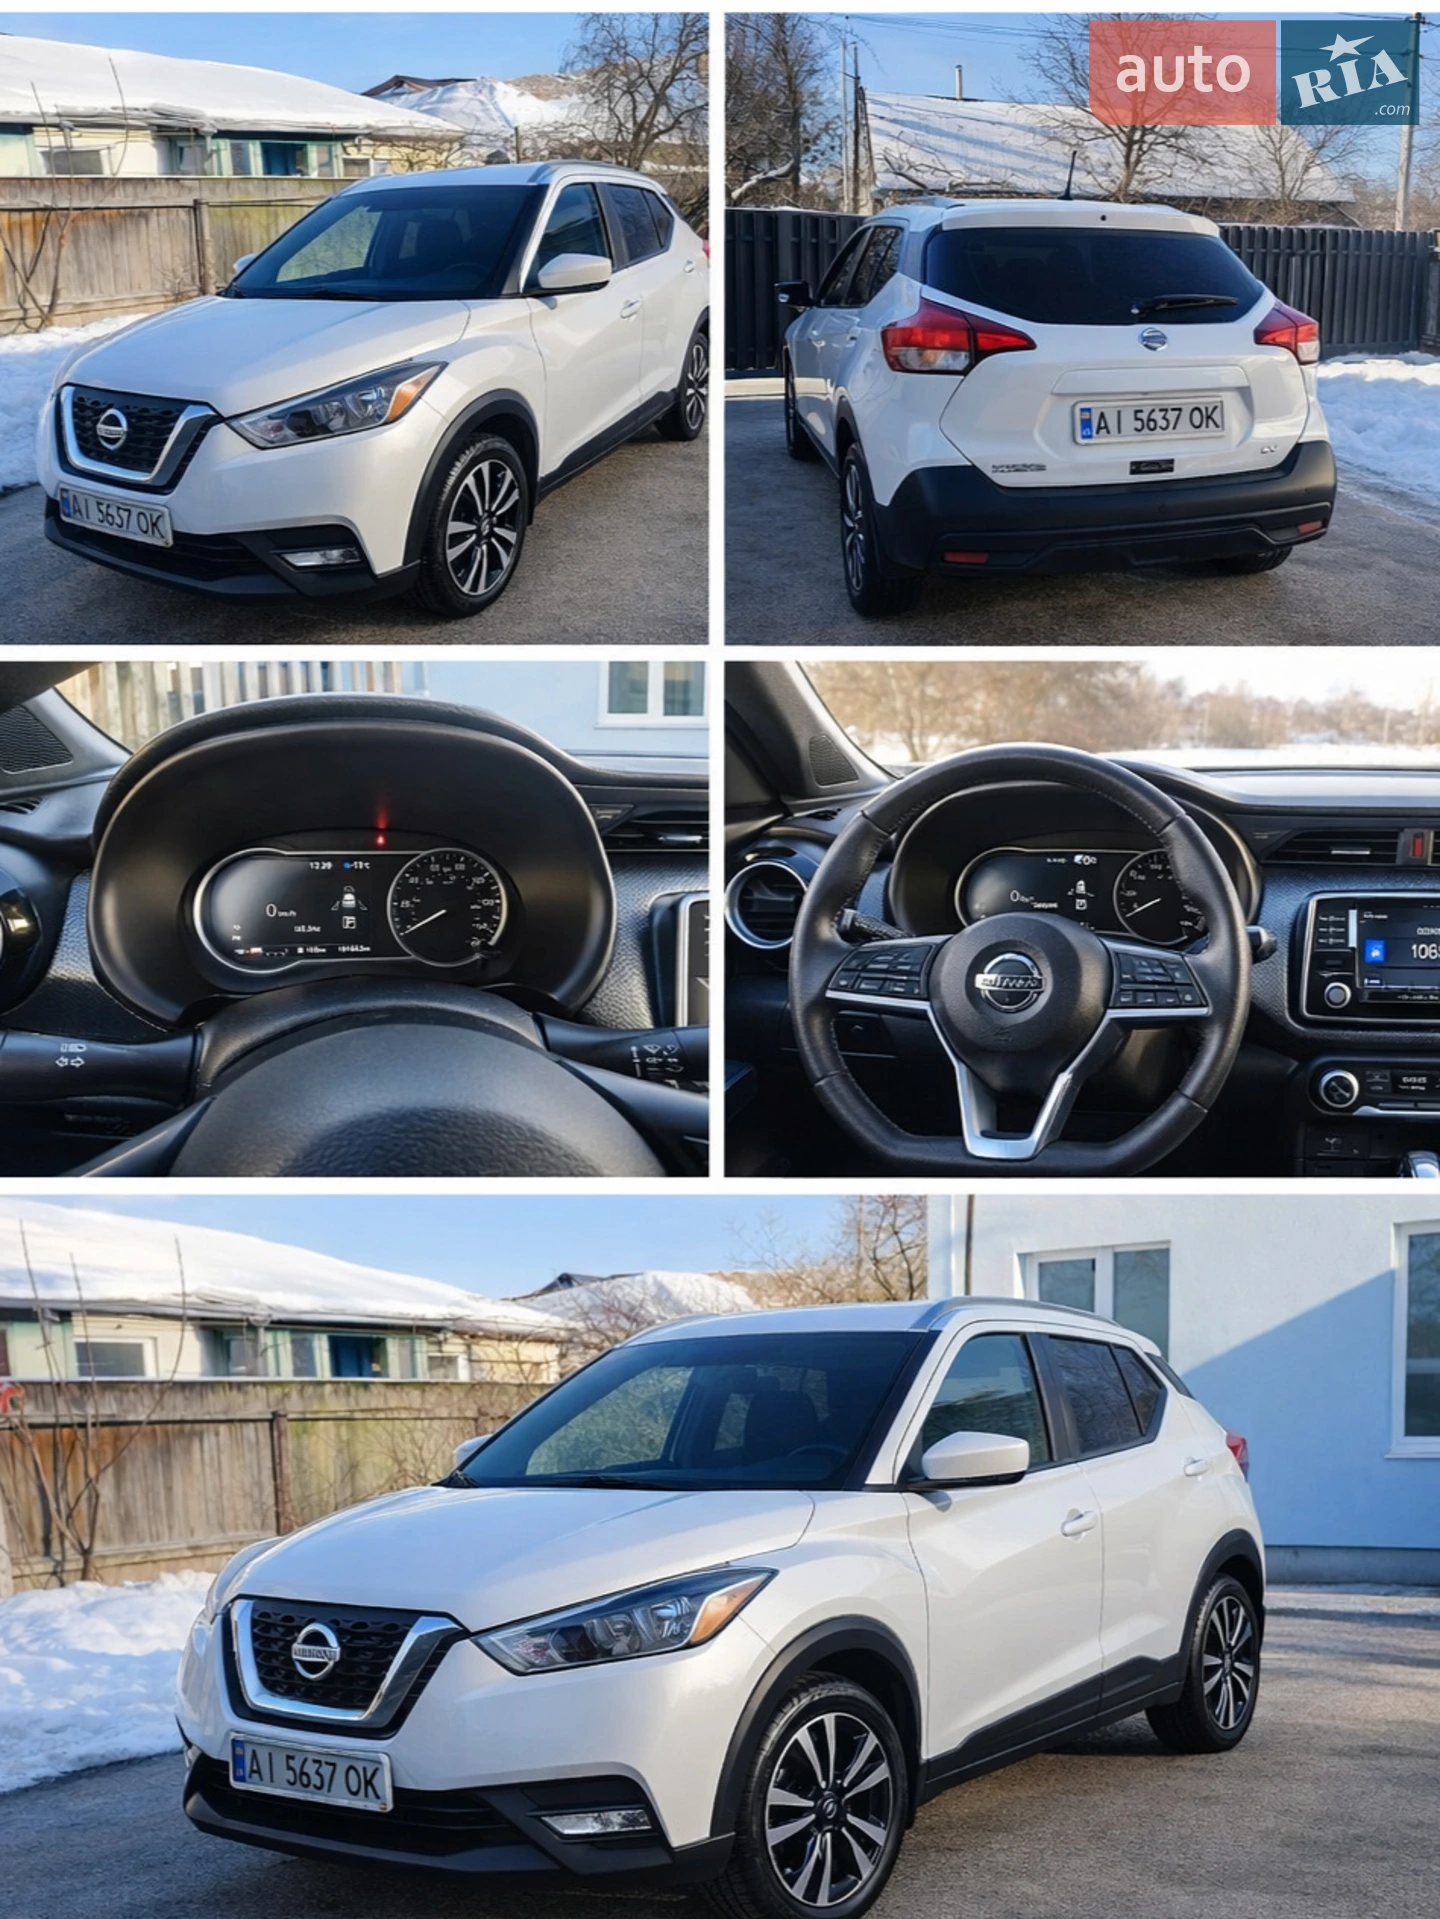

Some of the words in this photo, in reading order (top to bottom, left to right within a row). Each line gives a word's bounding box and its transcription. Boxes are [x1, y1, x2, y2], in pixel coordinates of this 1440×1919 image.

[1095, 409, 1123, 435] AI
[1133, 407, 1182, 432] 5637
[1189, 405, 1220, 429] OK
[72, 494, 90, 520] AI
[137, 511, 165, 539] OK
[248, 1749, 274, 1783] AI
[285, 1754, 337, 1793] 5637
[344, 1765, 381, 1800] OK
